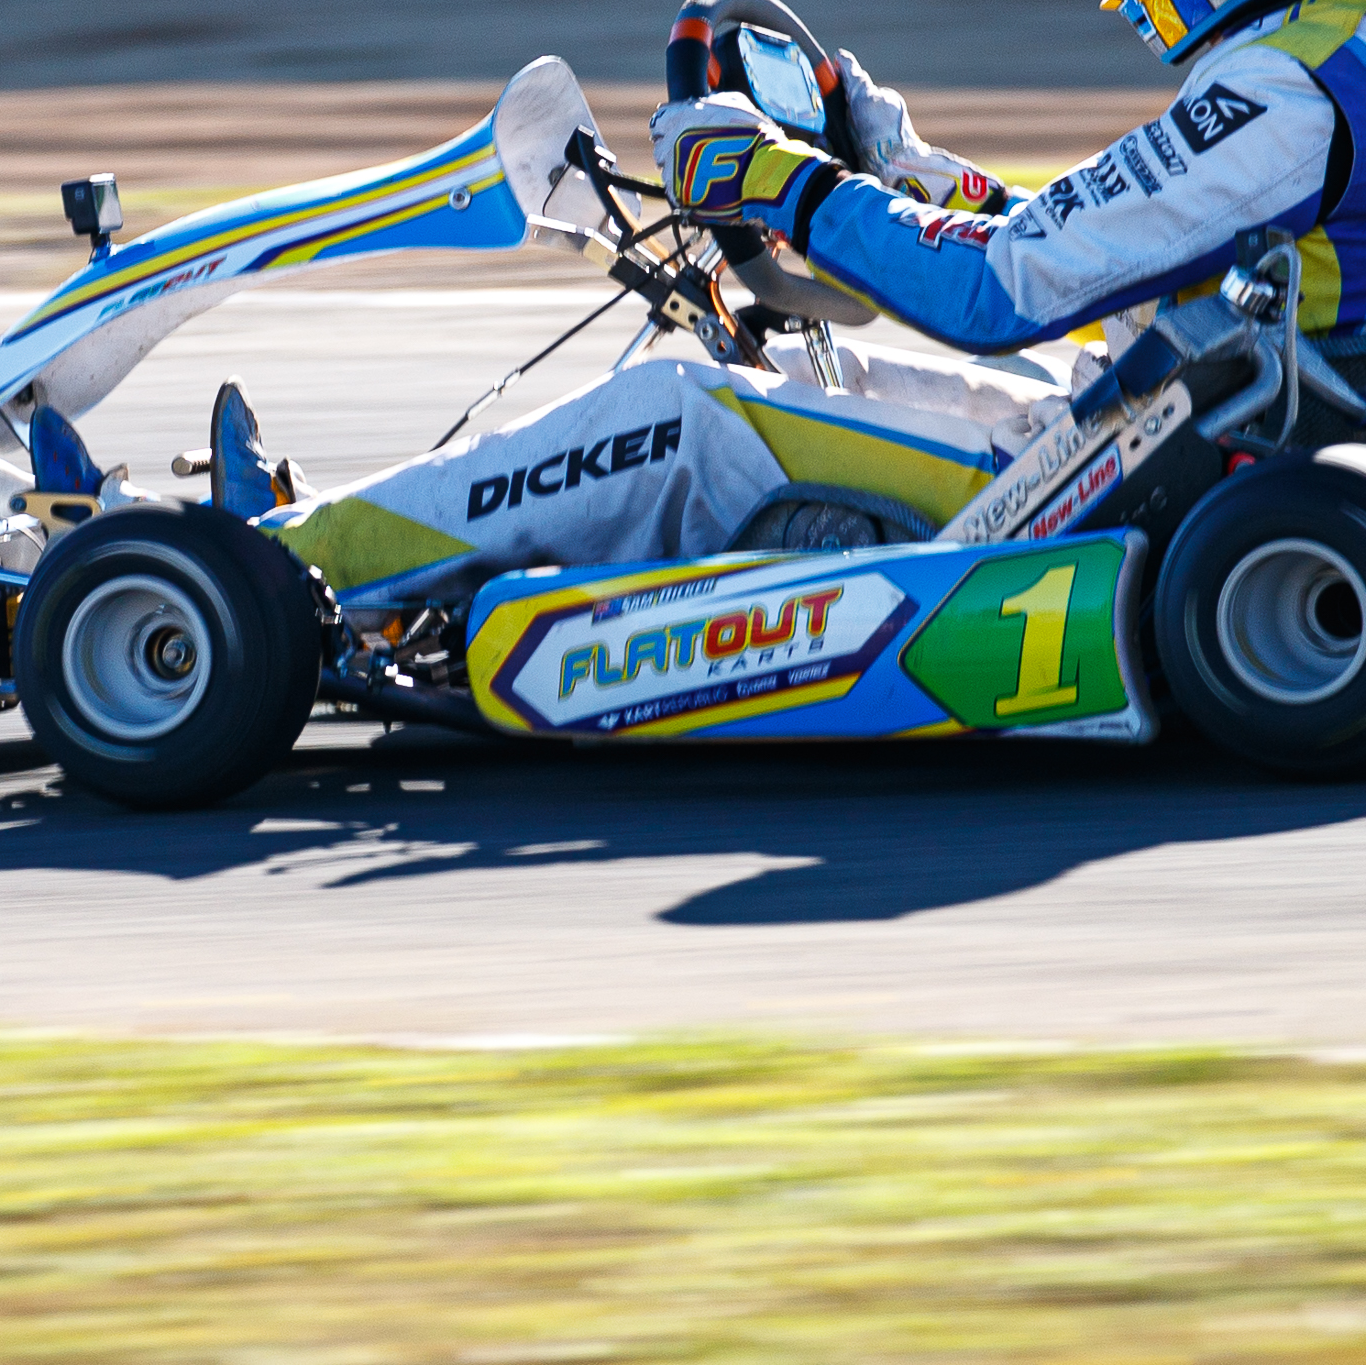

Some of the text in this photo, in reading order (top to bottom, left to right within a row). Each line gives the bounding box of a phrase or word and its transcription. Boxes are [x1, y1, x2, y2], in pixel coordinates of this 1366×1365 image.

[466, 416, 682, 524] DICKER
[1032, 456, 1116, 540] New-Line
[559, 585, 843, 702] FLATOUT
[708, 638, 825, 678] KARTS
[995, 562, 1078, 718] 1
